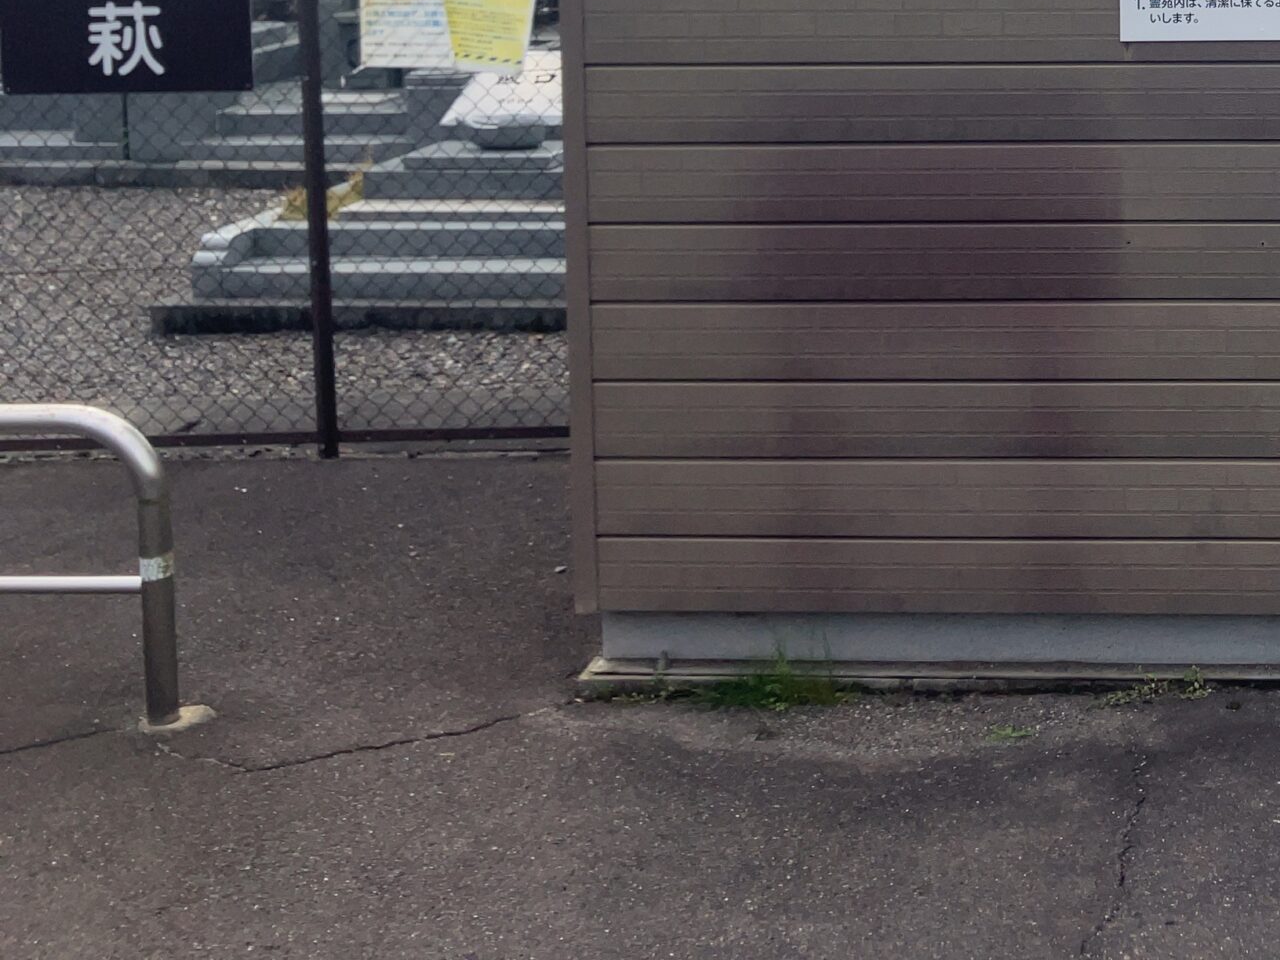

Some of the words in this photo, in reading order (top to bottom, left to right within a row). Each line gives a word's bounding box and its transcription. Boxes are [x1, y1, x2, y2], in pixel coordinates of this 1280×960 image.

[88, 0, 165, 76] 萩
[1149, 12, 1199, 24] いします。
